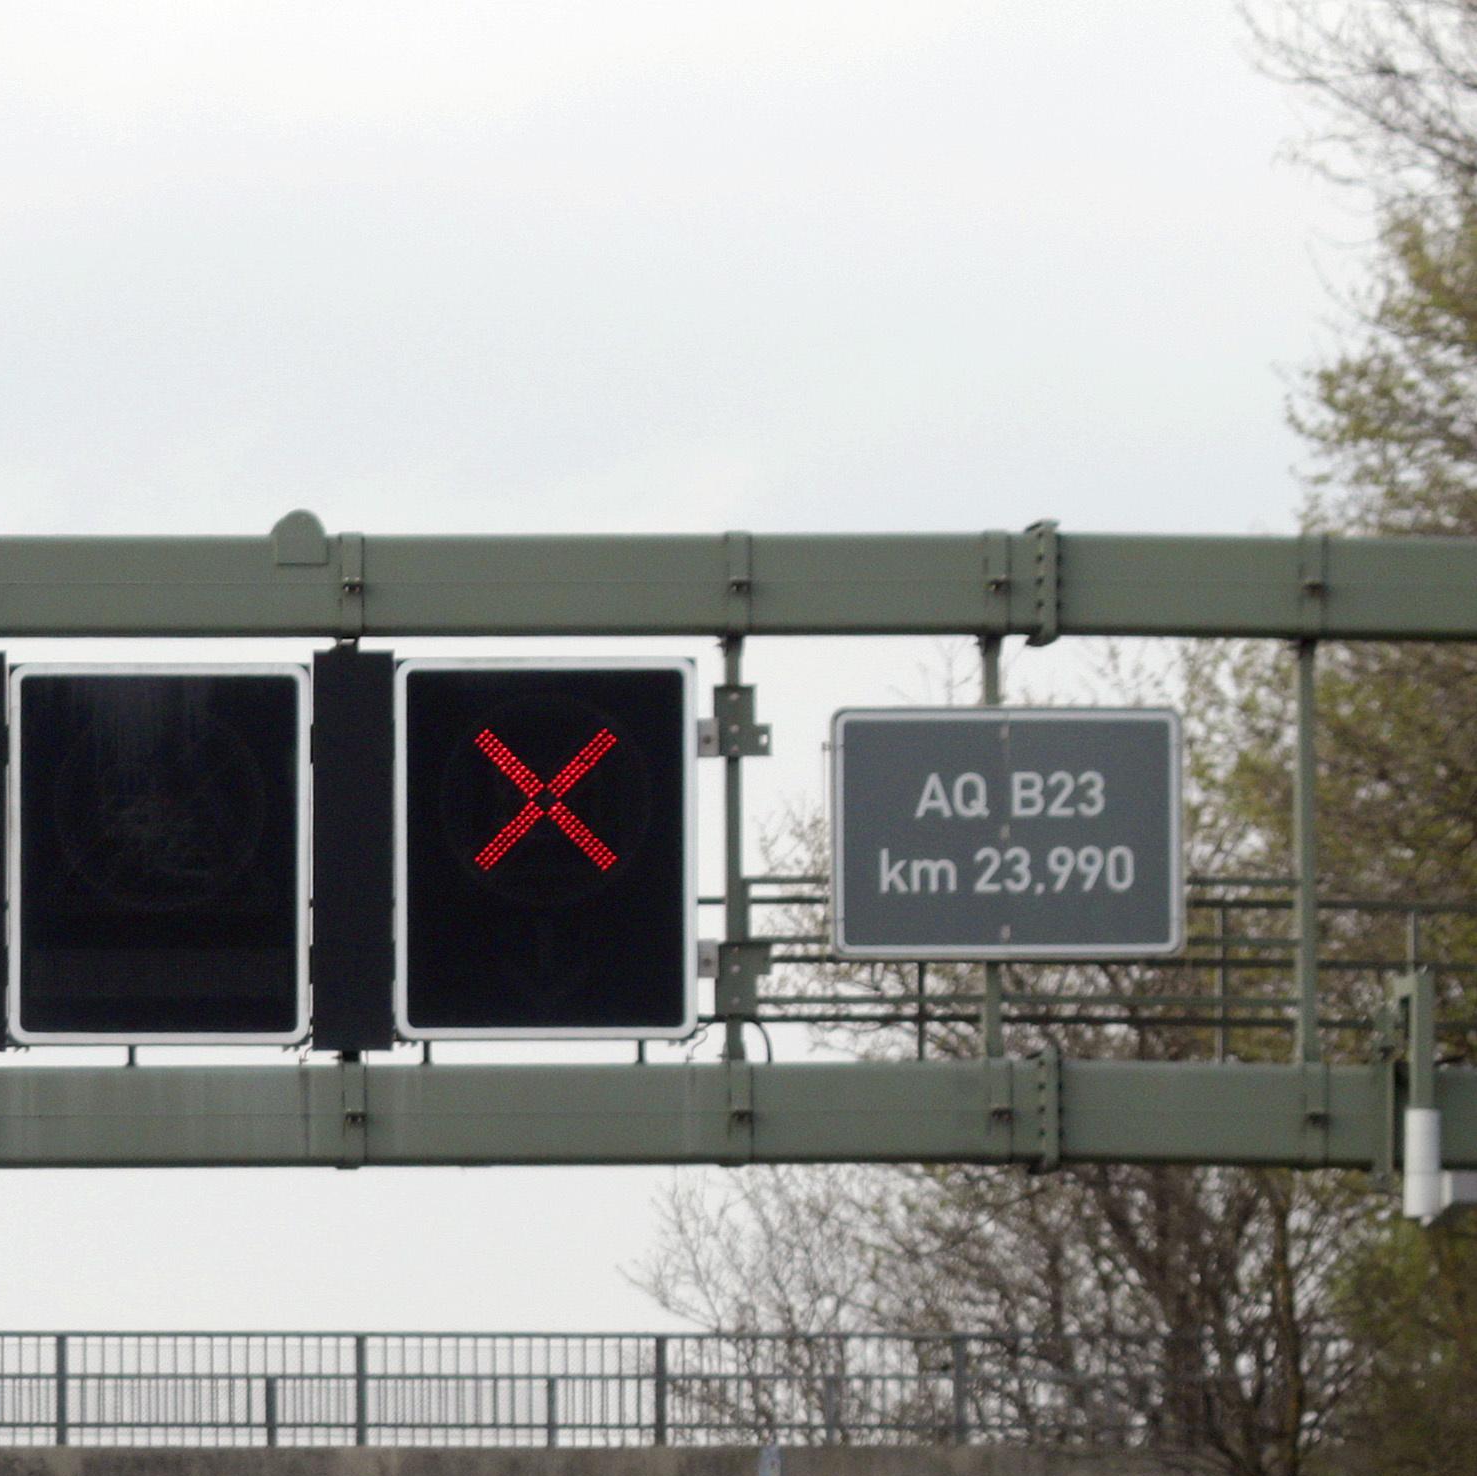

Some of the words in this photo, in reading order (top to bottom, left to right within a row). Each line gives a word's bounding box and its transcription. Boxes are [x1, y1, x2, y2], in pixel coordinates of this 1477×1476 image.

[915, 771, 990, 820] AQ
[1010, 770, 1106, 818] B23
[879, 847, 958, 894] km
[973, 845, 1136, 895] 23,990
